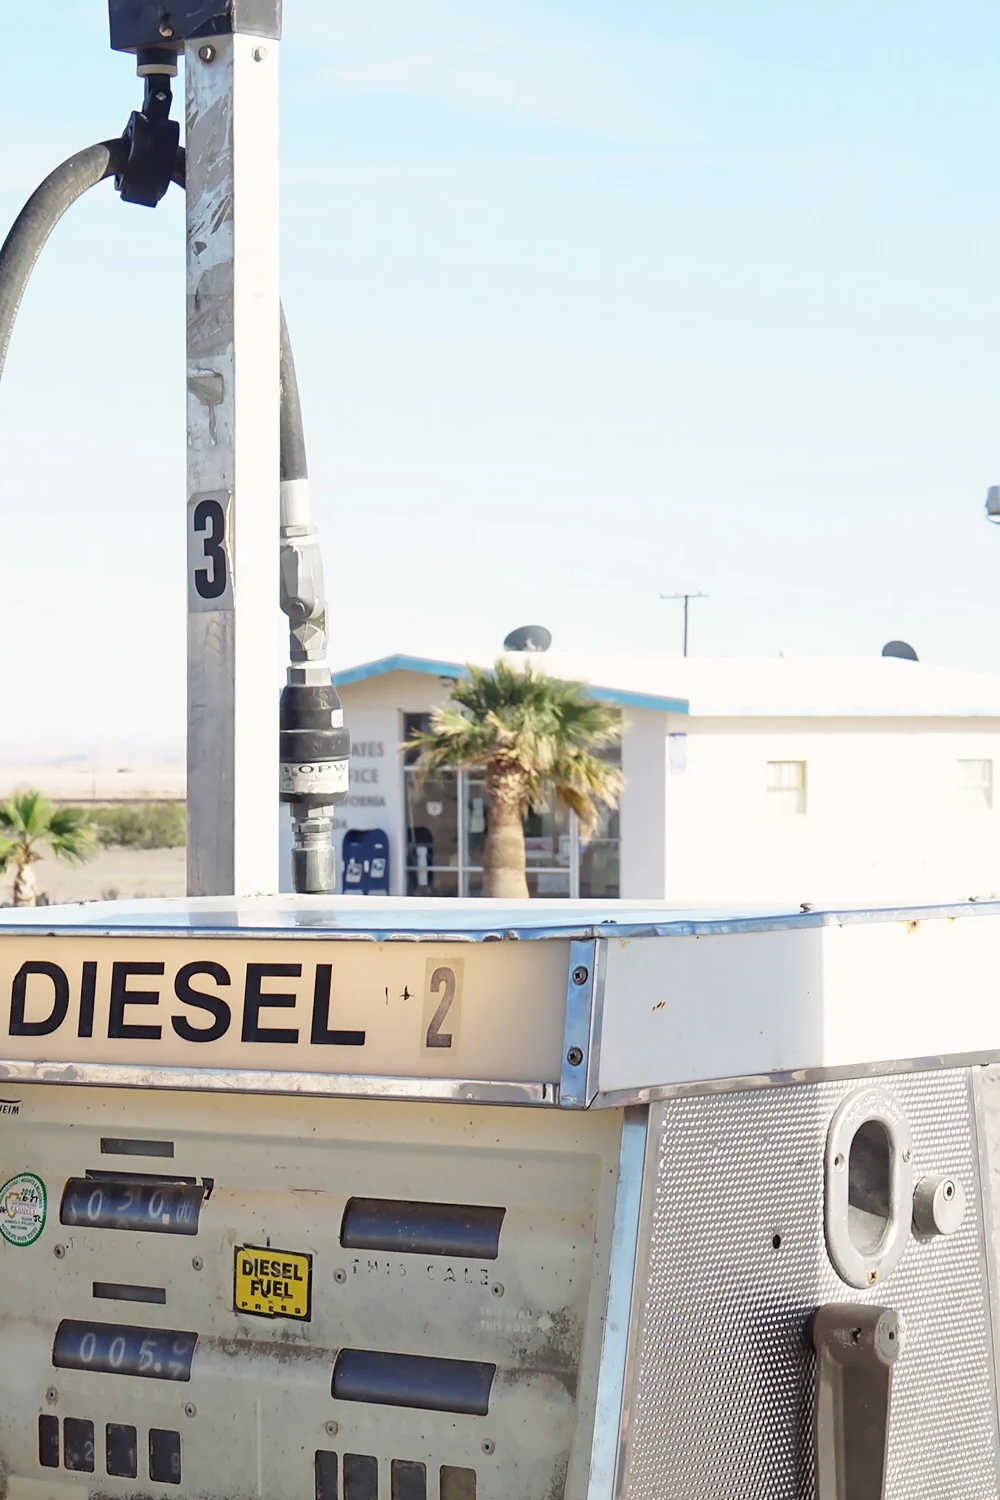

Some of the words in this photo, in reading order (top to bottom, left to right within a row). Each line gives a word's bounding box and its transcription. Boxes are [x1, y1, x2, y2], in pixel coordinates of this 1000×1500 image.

[194, 500, 227, 599] 3
[350, 741, 385, 757] ATES
[299, 764, 347, 774] OPW
[349, 768, 379, 783] FICE
[8, 960, 366, 1047] DIESEL
[426, 966, 456, 1048] 2
[242, 1258, 303, 1282] DIESEL
[250, 1278, 293, 1300] FUEL
[241, 1301, 301, 1314] PRESS
